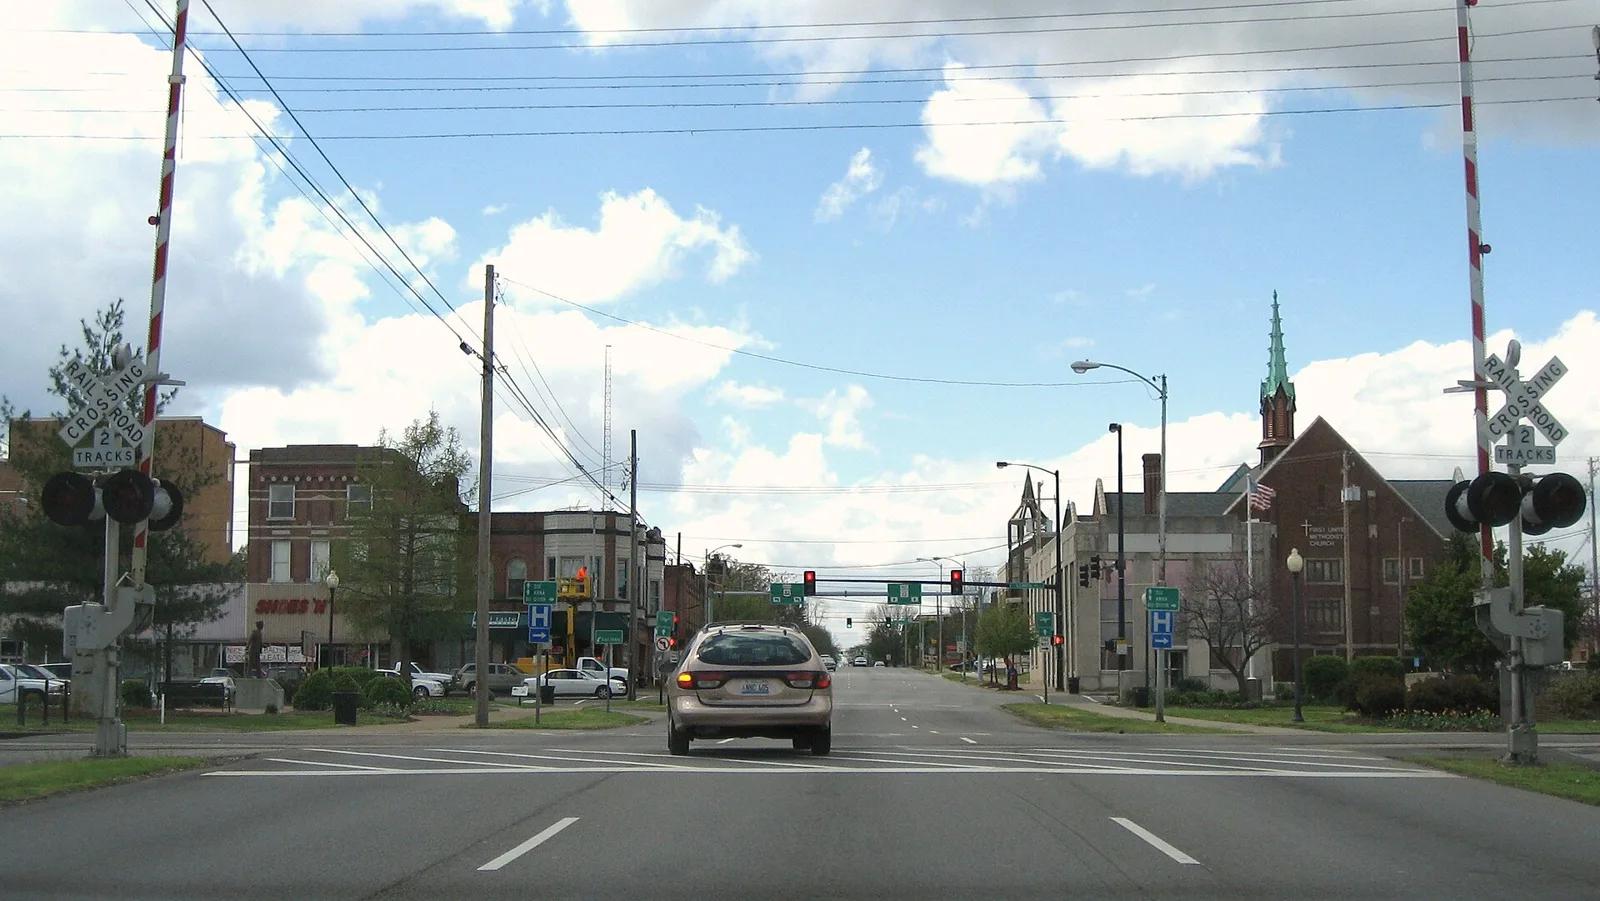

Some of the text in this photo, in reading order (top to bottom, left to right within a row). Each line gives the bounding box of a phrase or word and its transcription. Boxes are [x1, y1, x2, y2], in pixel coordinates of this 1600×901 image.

[66, 361, 98, 397] RAIL
[1484, 357, 1516, 393] RAIL
[67, 365, 143, 439] CROSSING
[1489, 363, 1561, 436] CROSSING
[110, 408, 144, 443] ROAD
[1521, 430, 1530, 444] 2
[1530, 405, 1563, 442] ROAD
[100, 432, 110, 445] 2
[76, 450, 133, 463] TRACKS
[1497, 449, 1554, 460] TRACKS
[531, 606, 548, 627] H
[1153, 612, 1172, 633] H
